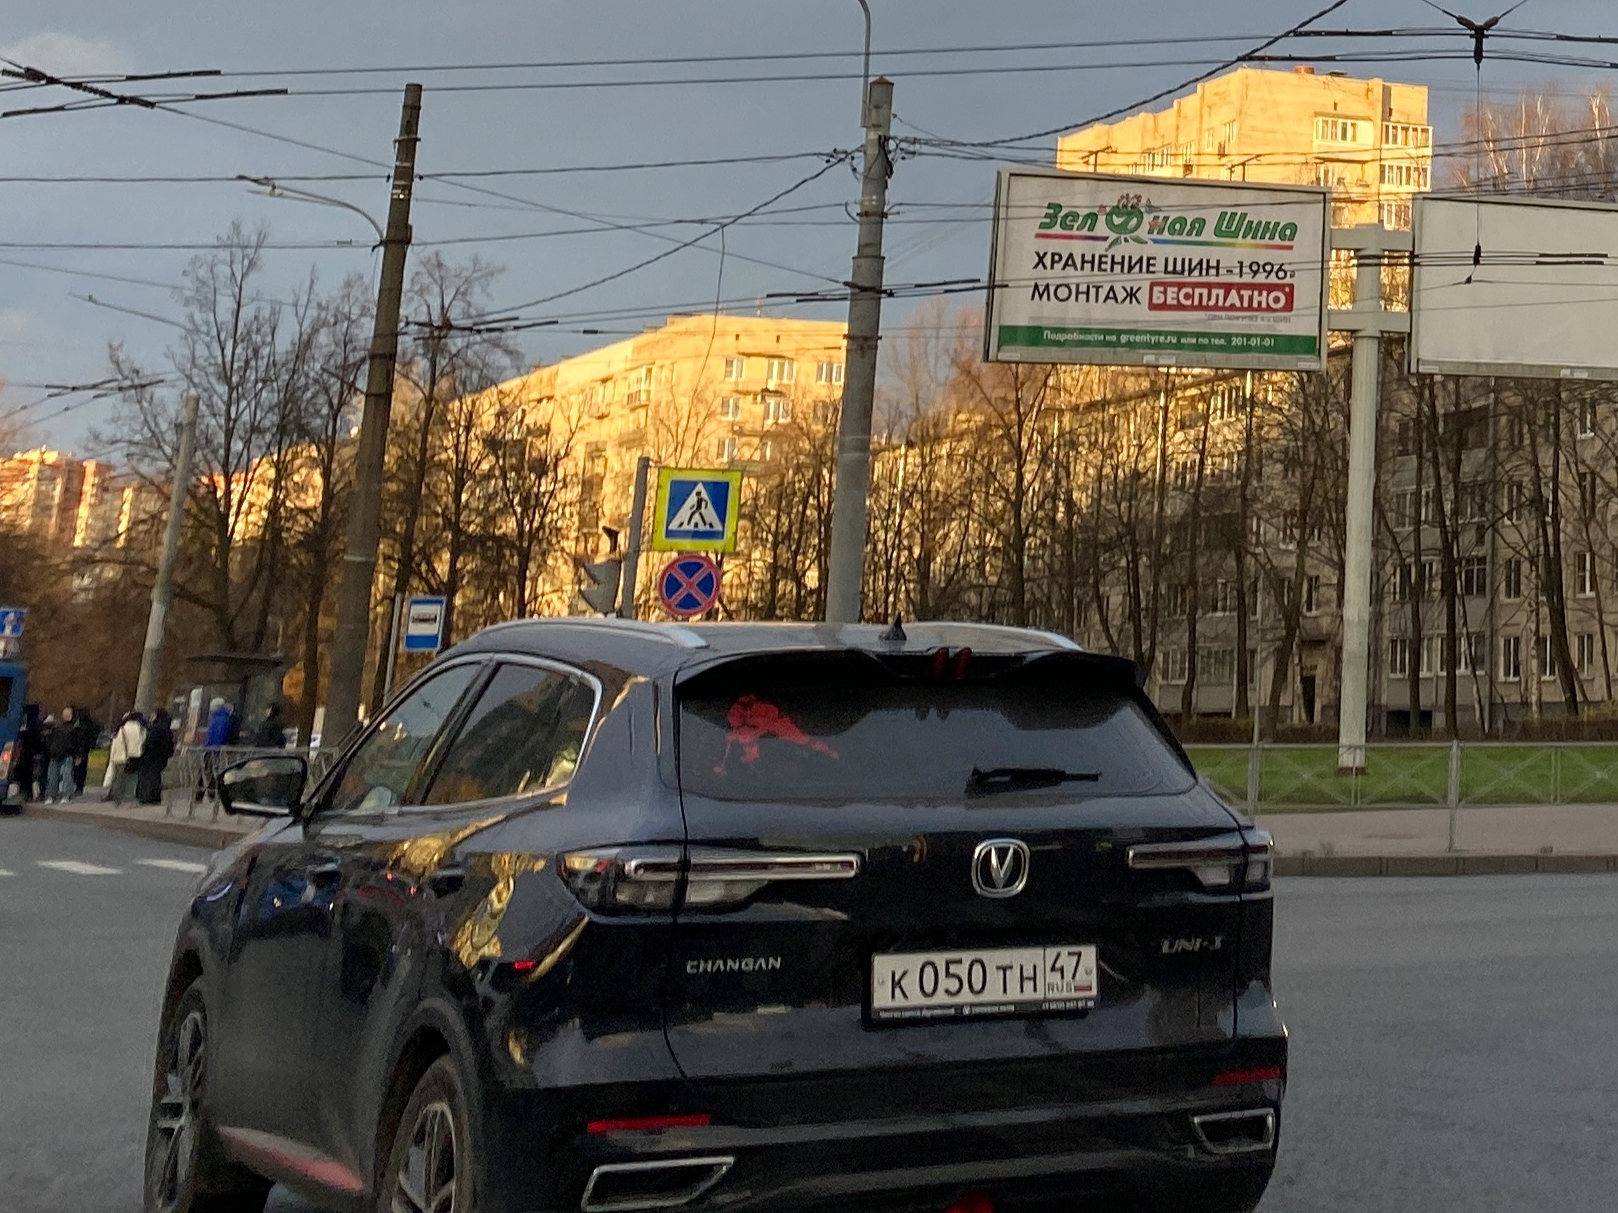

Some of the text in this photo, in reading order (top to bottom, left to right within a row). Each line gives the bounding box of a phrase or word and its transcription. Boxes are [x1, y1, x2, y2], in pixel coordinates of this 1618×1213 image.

[1213, 210, 1298, 242] Шина
[1032, 250, 1157, 274] ХРАНЕНИЕ
[1163, 255, 1221, 278] ШИН
[1030, 281, 1143, 305] МОНТАЖ
[1043, 330, 1104, 342] Подробности
[1105, 334, 1117, 342] на
[1120, 333, 1177, 345] greentyre.ru
[1180, 336, 1196, 344] или
[1231, 336, 1274, 347] 201-01-01
[686, 956, 781, 974] CHANGAN
[1050, 950, 1082, 980] 47
